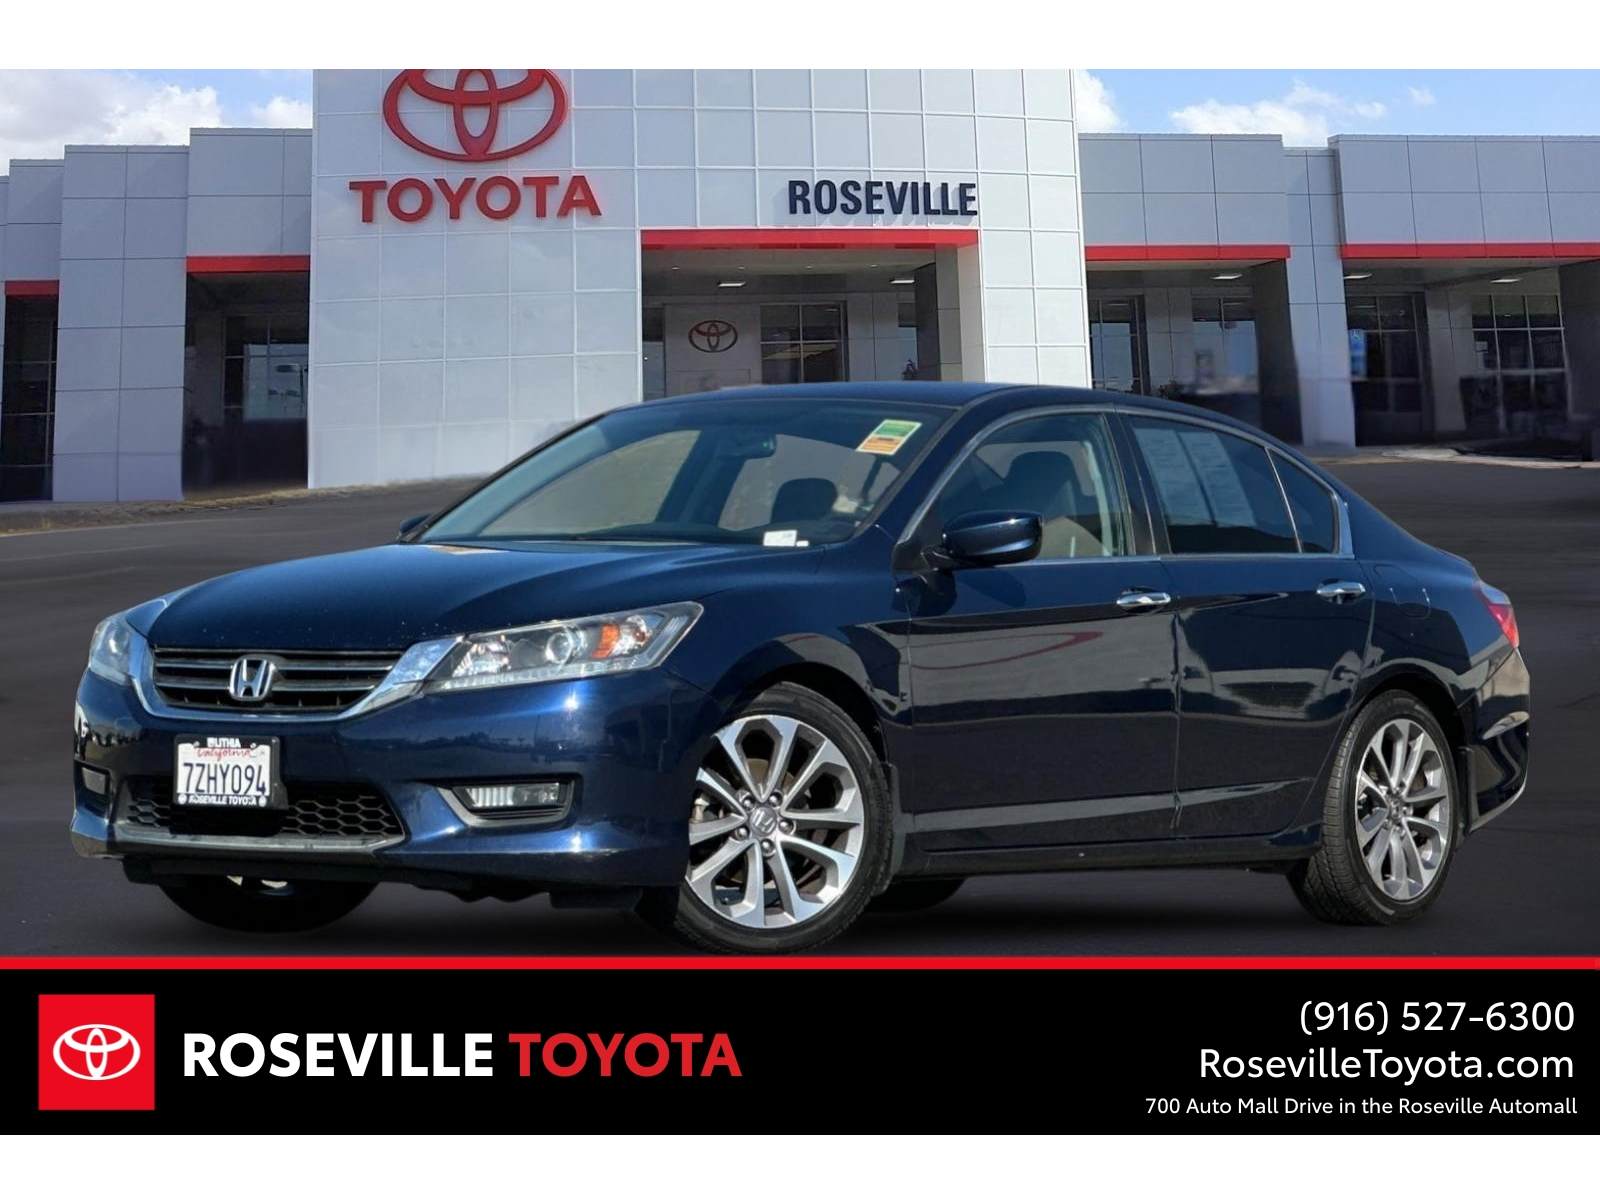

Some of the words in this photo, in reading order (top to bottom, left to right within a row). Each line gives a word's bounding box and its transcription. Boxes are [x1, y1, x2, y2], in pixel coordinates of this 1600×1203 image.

[349, 175, 602, 222] TOYOTA
[788, 180, 978, 216] ROSEVILLE
[183, 762, 266, 796] 7ZHY094
[229, 796, 257, 806] TOYOTA
